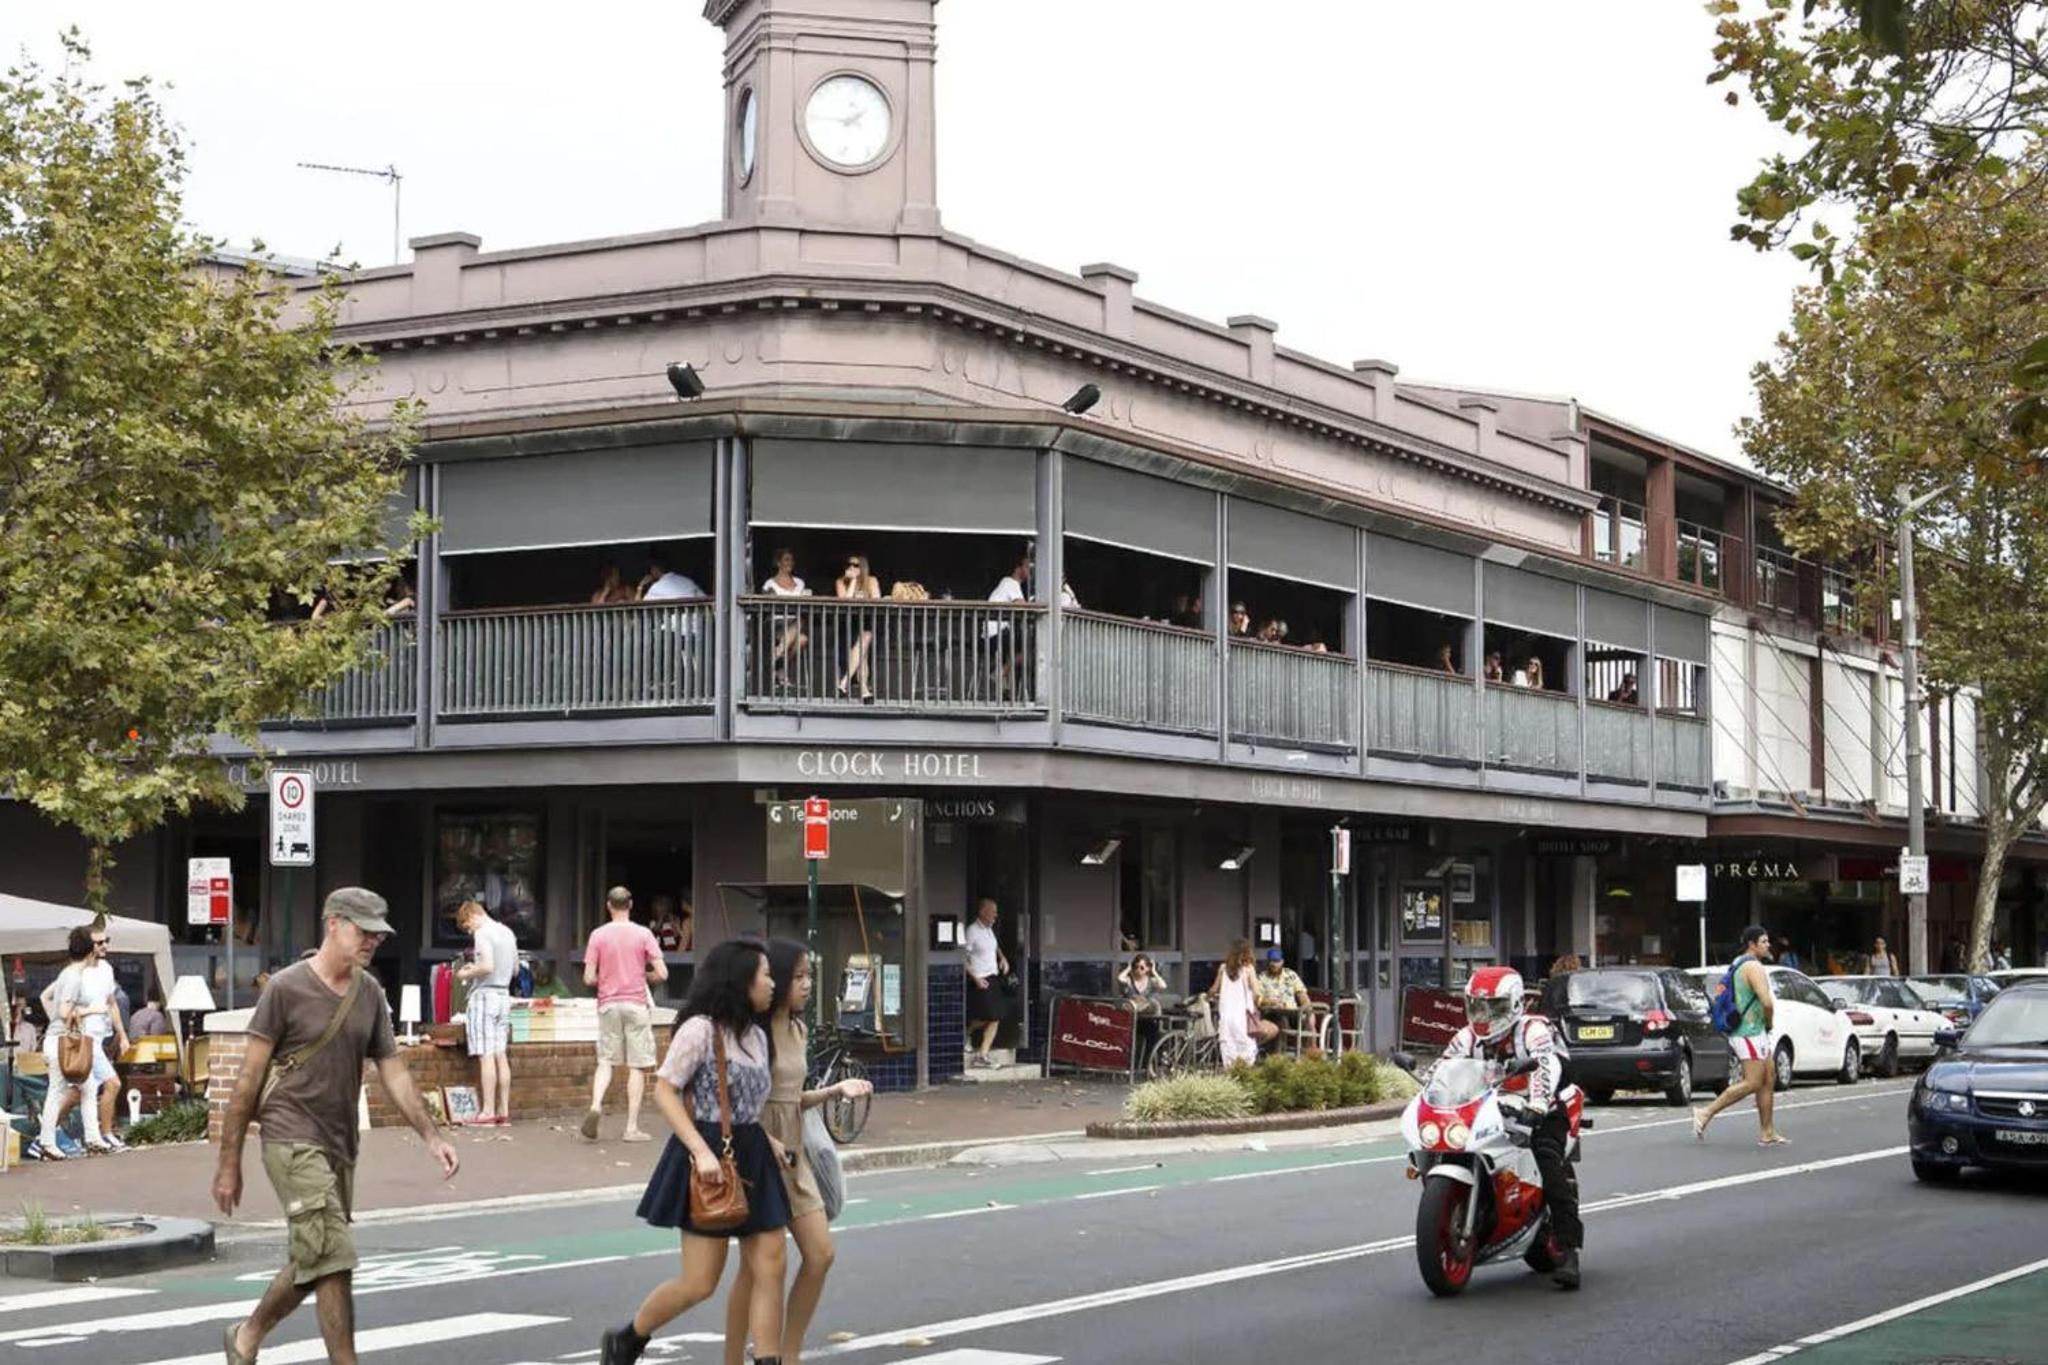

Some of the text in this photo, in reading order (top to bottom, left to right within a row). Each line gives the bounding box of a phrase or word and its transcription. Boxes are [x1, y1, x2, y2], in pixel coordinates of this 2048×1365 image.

[797, 751, 985, 778] CLOCK HOTEL
[286, 785, 299, 799] 10
[789, 806, 858, 821] Teone
[925, 800, 995, 817] UNCTIONS
